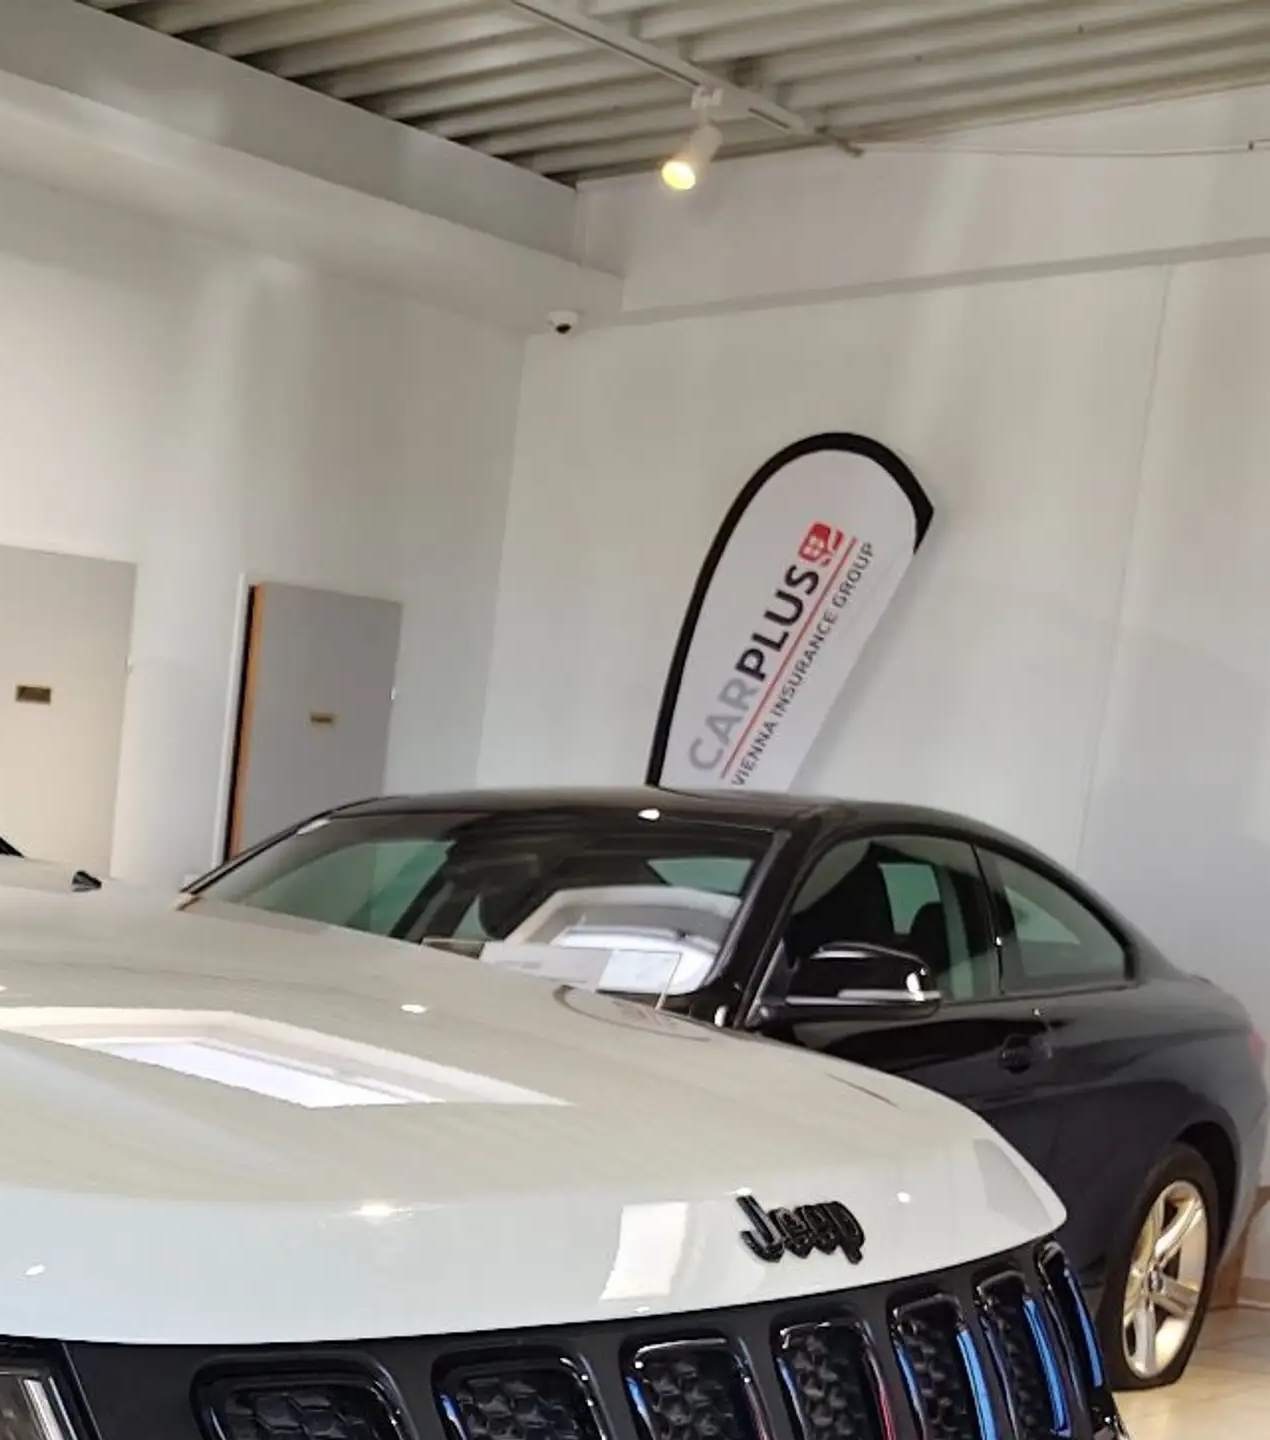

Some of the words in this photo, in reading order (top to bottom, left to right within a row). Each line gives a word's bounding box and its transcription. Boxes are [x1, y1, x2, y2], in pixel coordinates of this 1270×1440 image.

[731, 719, 778, 786] VIENNA
[771, 608, 839, 718] INSURANCE
[831, 541, 874, 610] GROUP
[736, 1195, 865, 1265] Jeep
